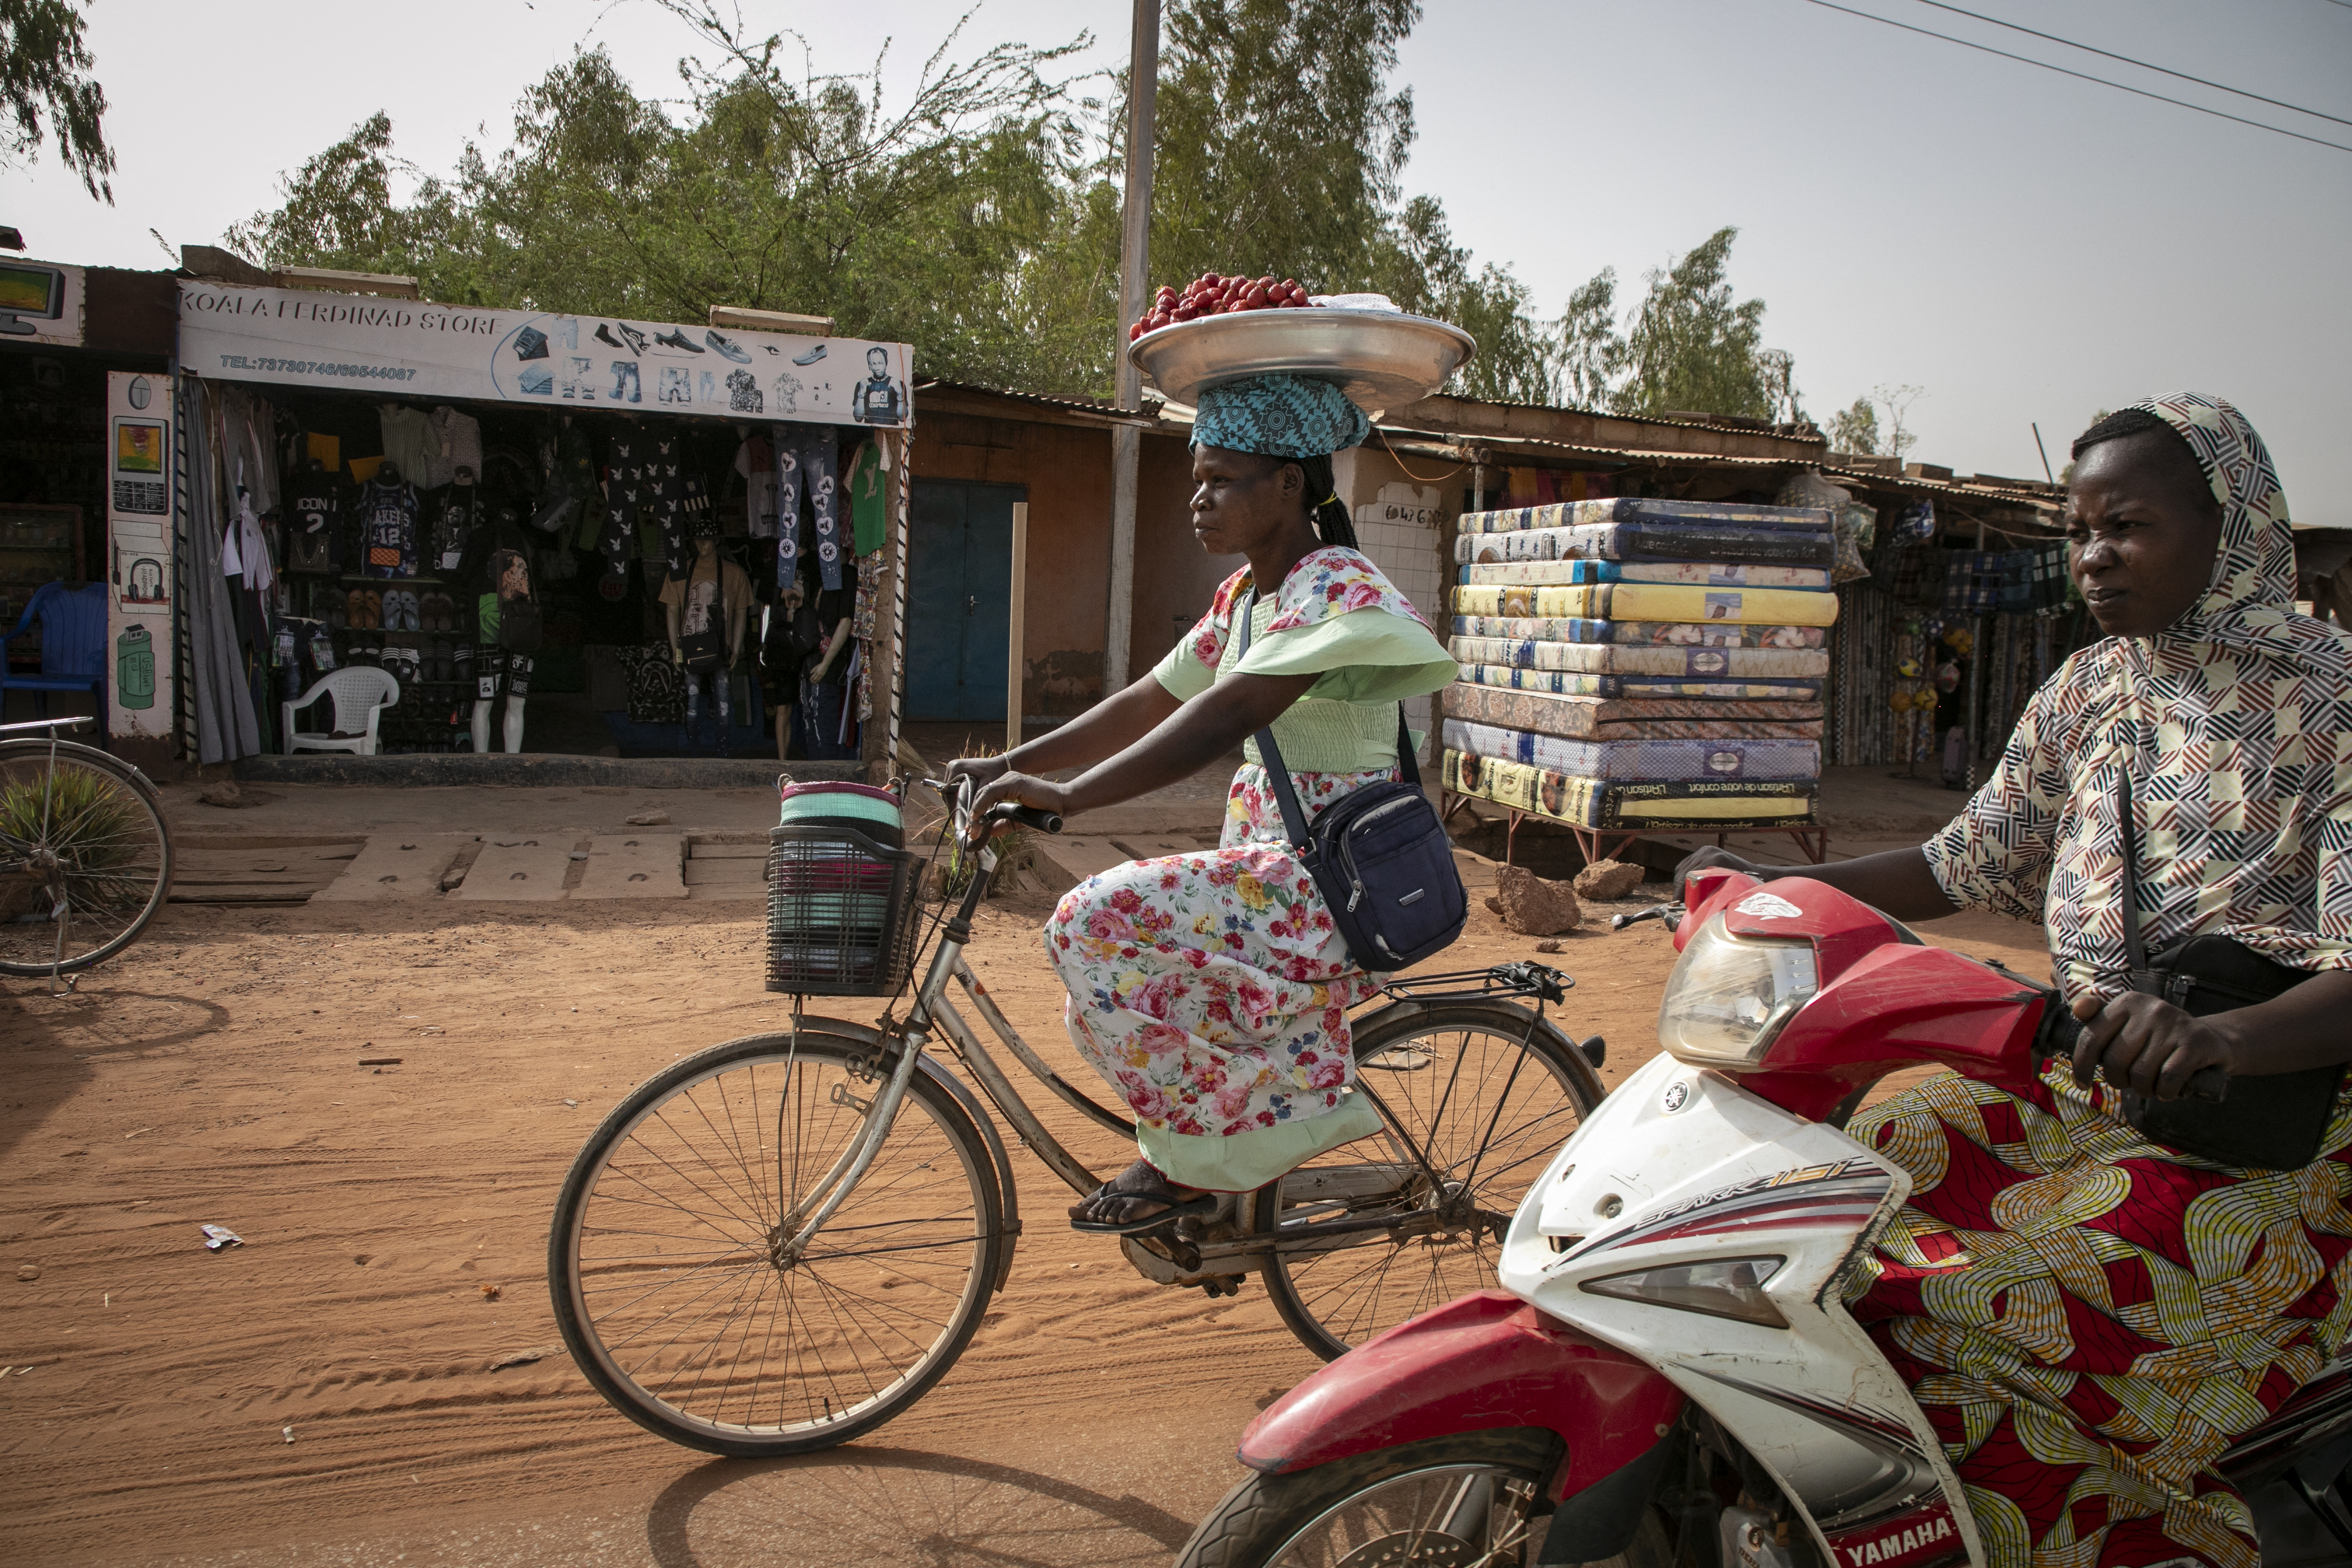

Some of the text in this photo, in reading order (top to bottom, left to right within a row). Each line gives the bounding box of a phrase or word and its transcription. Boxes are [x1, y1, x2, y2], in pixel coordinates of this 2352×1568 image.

[179, 292, 504, 335] KOALA FERDINAD STORE
[220, 354, 417, 381] TEL:73730746/69544087
[306, 513, 324, 533] 2
[379, 528, 400, 544] 12
[1785, 547, 1817, 558] cofort
[1626, 783, 1667, 795] L'Artisan
[1689, 783, 1720, 794] confort
[1720, 784, 1744, 793] votre
[1744, 783, 1756, 792] de
[1757, 783, 1795, 793] L'Artisan
[1634, 1178, 1757, 1230] SPARK
[1846, 1516, 1953, 1567] YAMAHA
